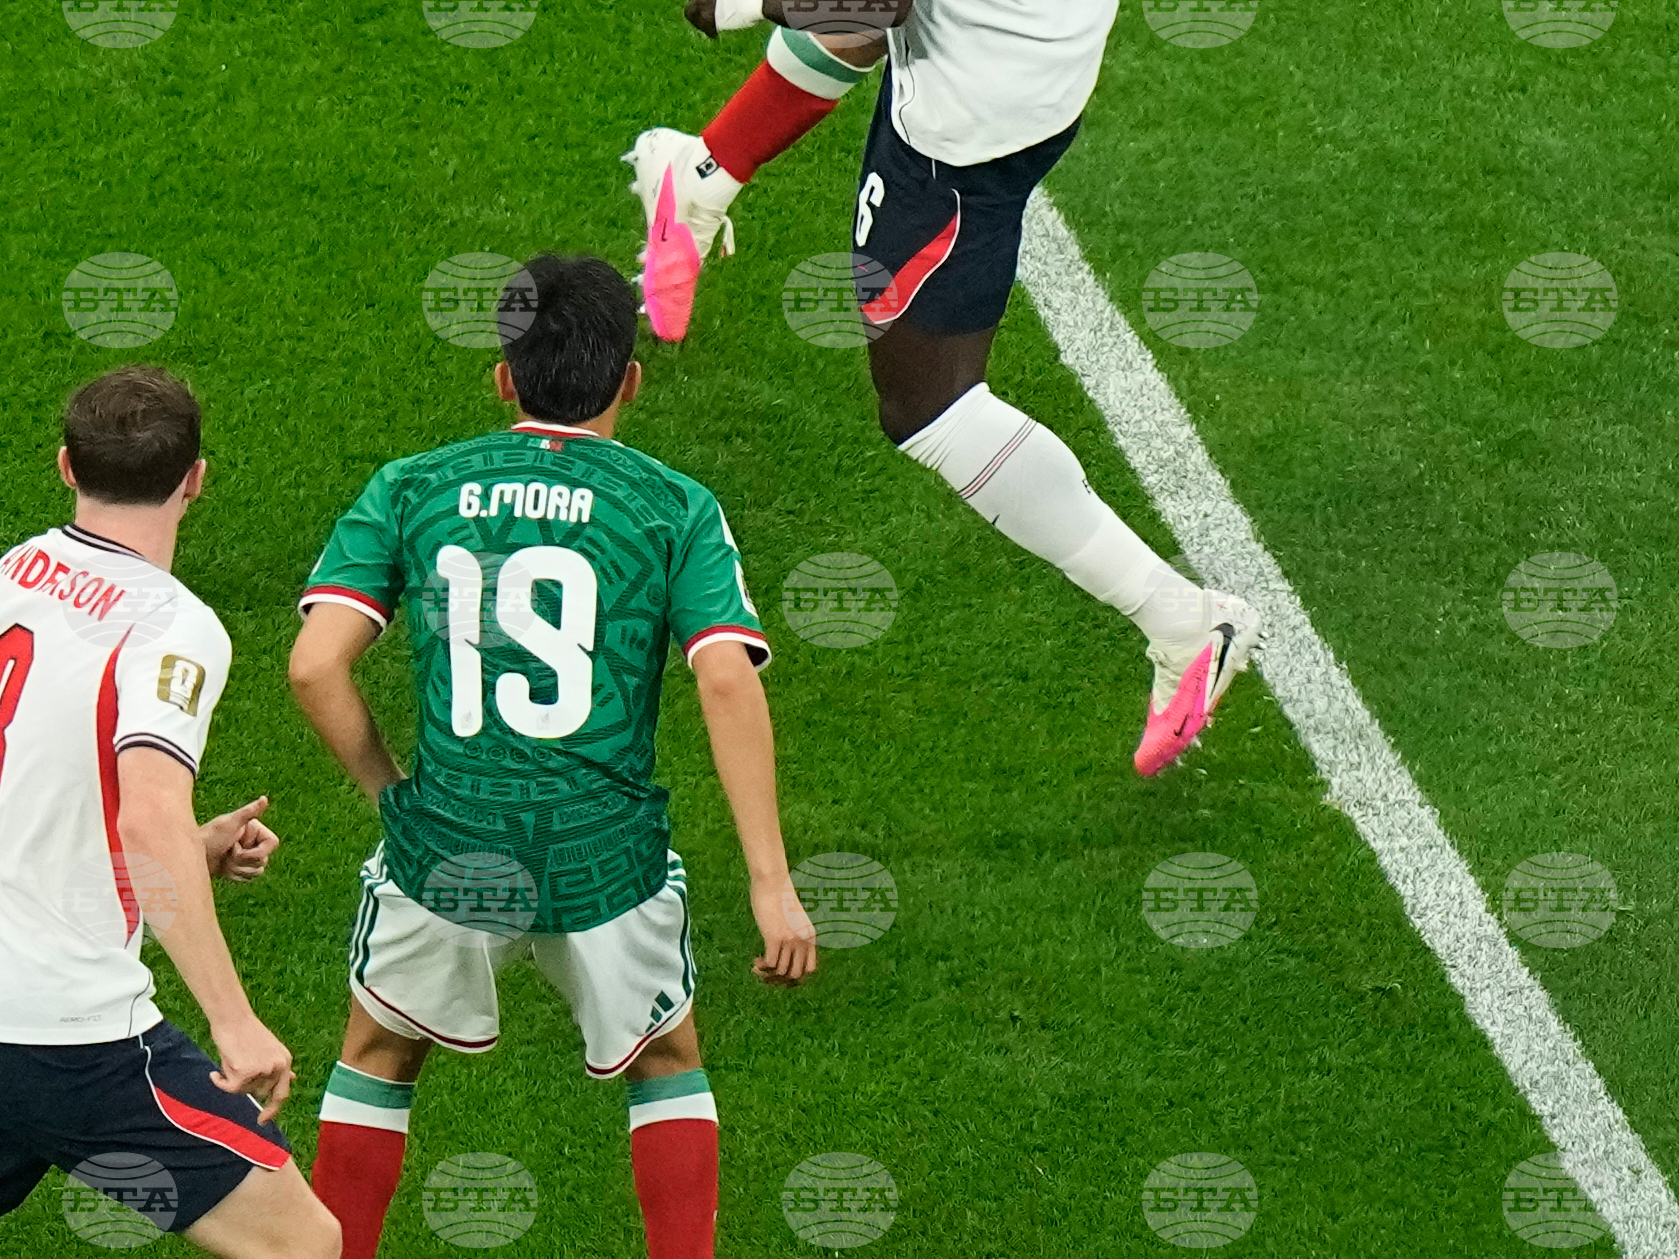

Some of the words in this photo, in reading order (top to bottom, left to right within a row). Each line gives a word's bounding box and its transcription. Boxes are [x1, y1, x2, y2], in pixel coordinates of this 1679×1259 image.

[855, 172, 885, 248] 6
[459, 482, 594, 523] G.MORA
[437, 544, 598, 739] 19
